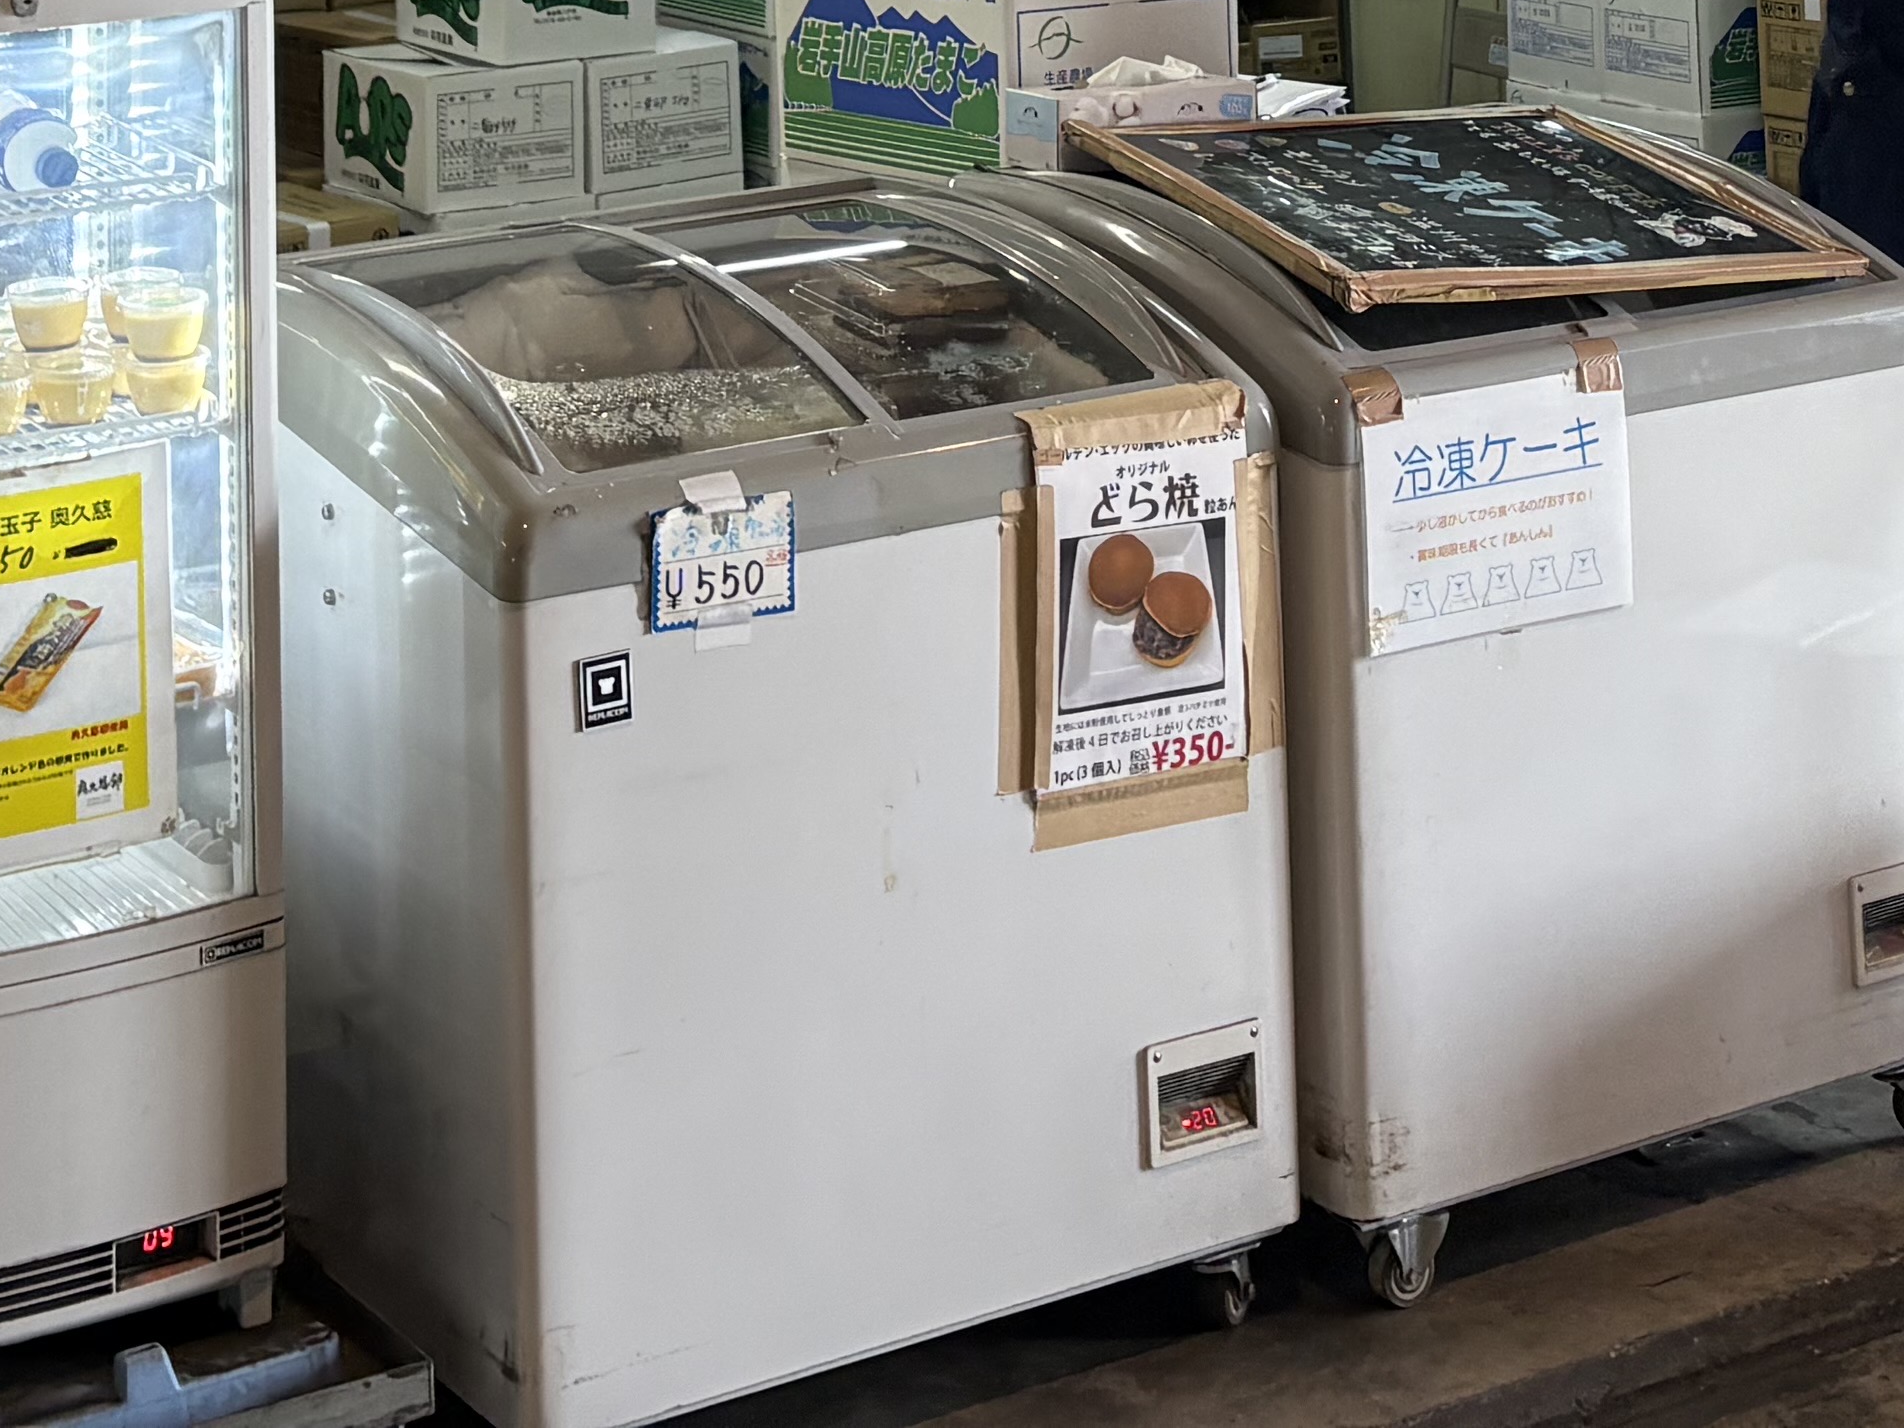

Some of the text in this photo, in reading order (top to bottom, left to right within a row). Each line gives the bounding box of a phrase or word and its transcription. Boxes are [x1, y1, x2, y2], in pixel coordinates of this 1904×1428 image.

[796, 15, 988, 99] 岩手山高原たまご
[1115, 459, 1171, 480] オリジナル
[1394, 416, 1600, 497] 冷凍ケーキ
[49, 499, 113, 529] 奥久慈
[1091, 472, 1201, 529] どら焼
